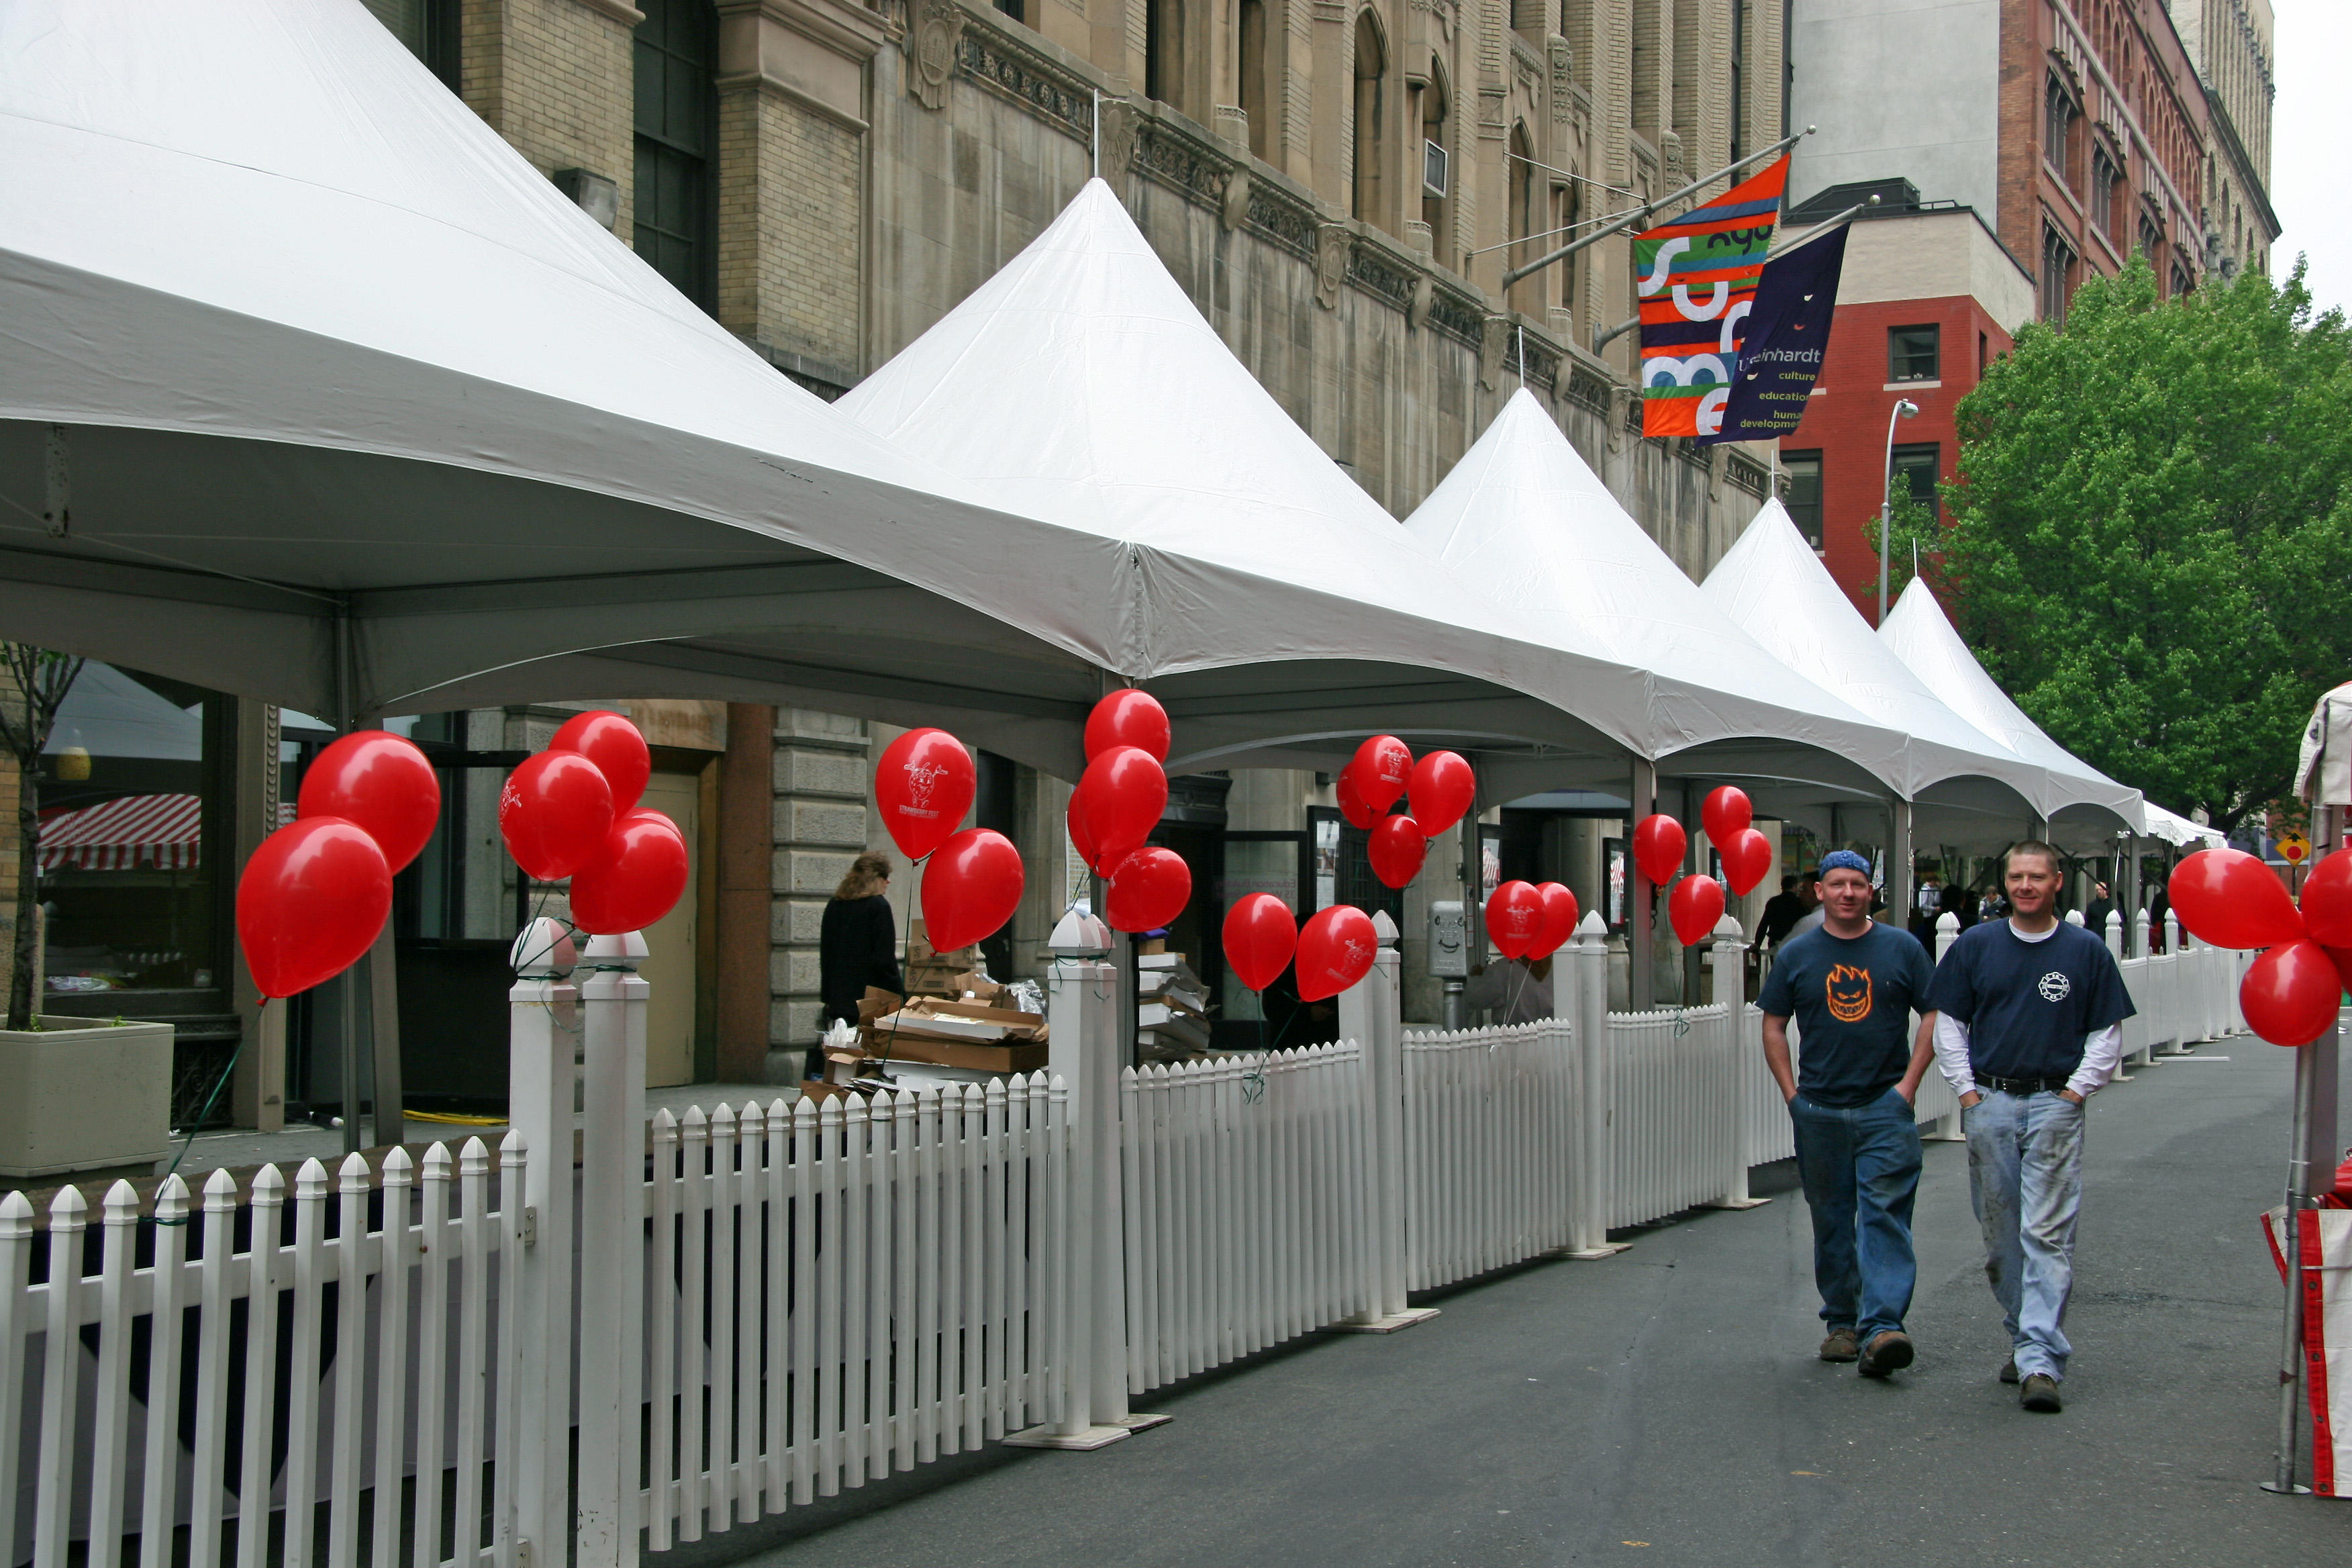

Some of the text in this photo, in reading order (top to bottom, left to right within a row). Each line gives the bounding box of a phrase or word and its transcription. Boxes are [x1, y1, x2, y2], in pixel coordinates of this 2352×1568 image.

[1778, 371, 1816, 381] culture
[1773, 410, 1802, 419] huma
[1740, 419, 1800, 429] developme
